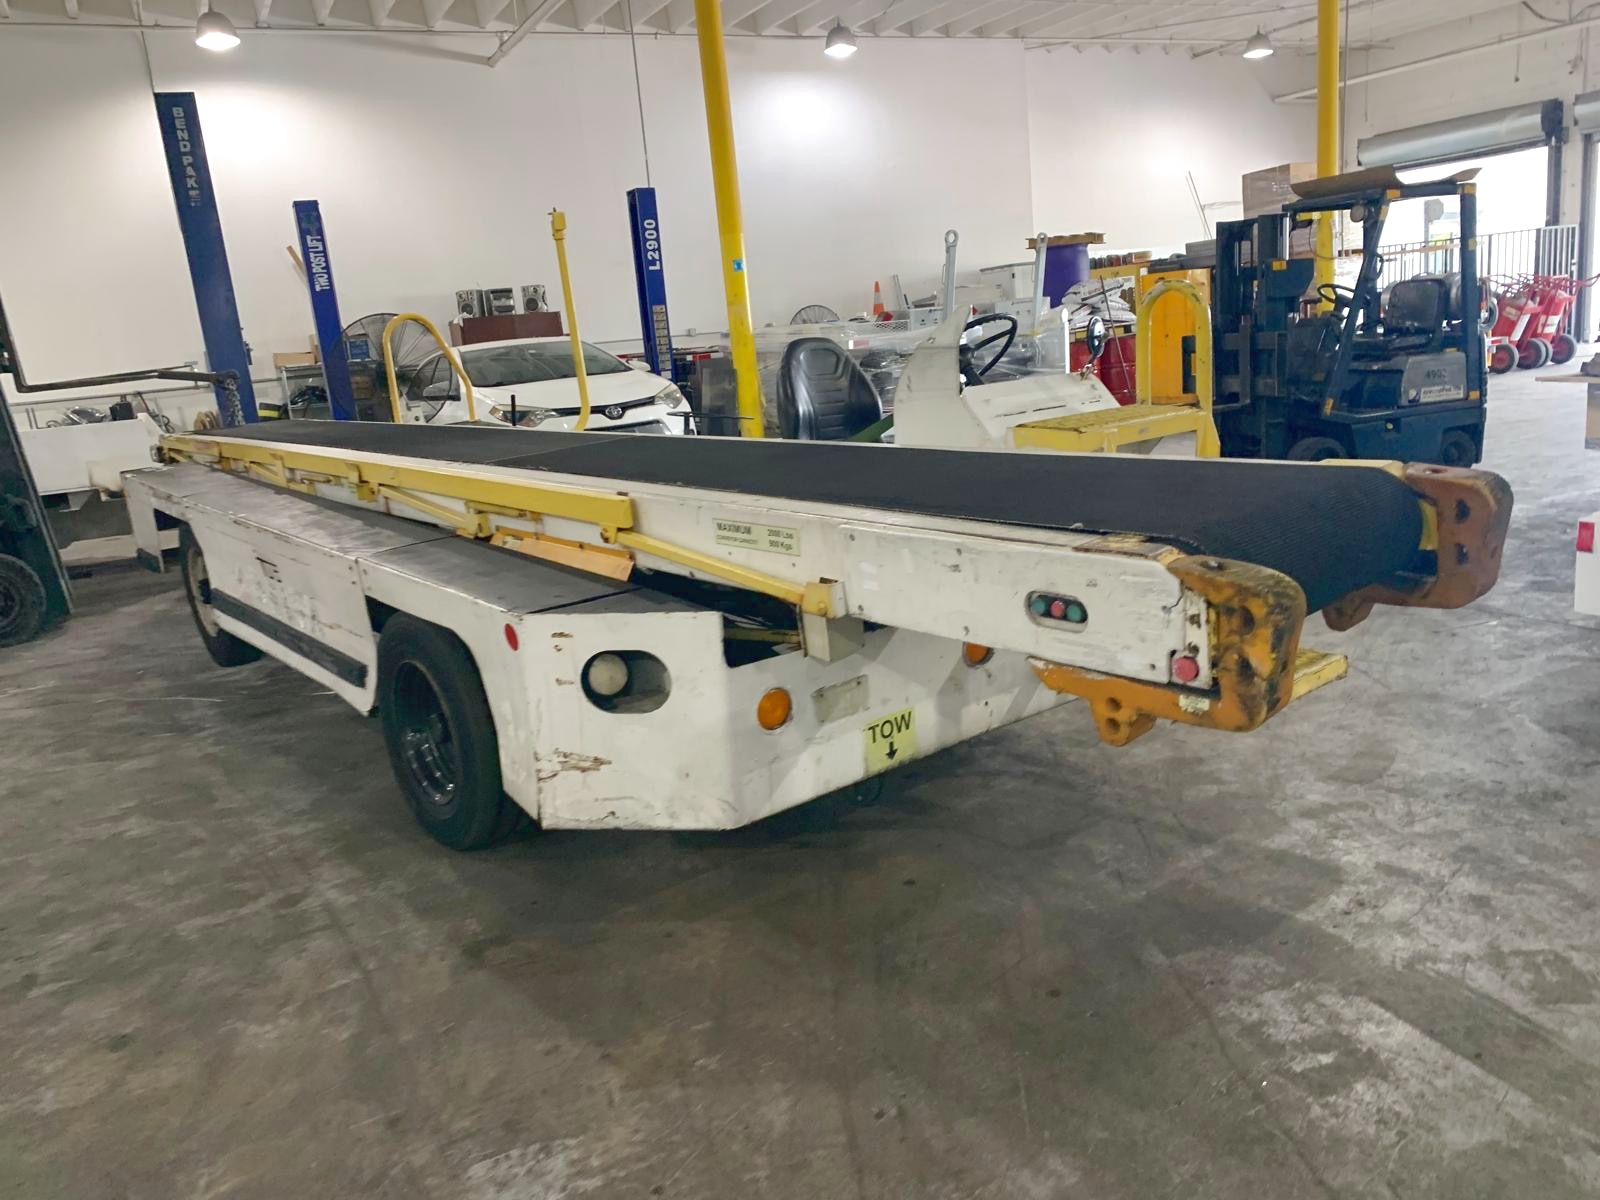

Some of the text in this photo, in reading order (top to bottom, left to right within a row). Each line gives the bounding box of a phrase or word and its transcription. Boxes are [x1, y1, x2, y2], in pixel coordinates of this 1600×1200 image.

[306, 235, 330, 292] TWO POST LIFT
[643, 219, 661, 271] L2900
[716, 522, 752, 535] MAXIMUM
[867, 710, 912, 744] TOW
